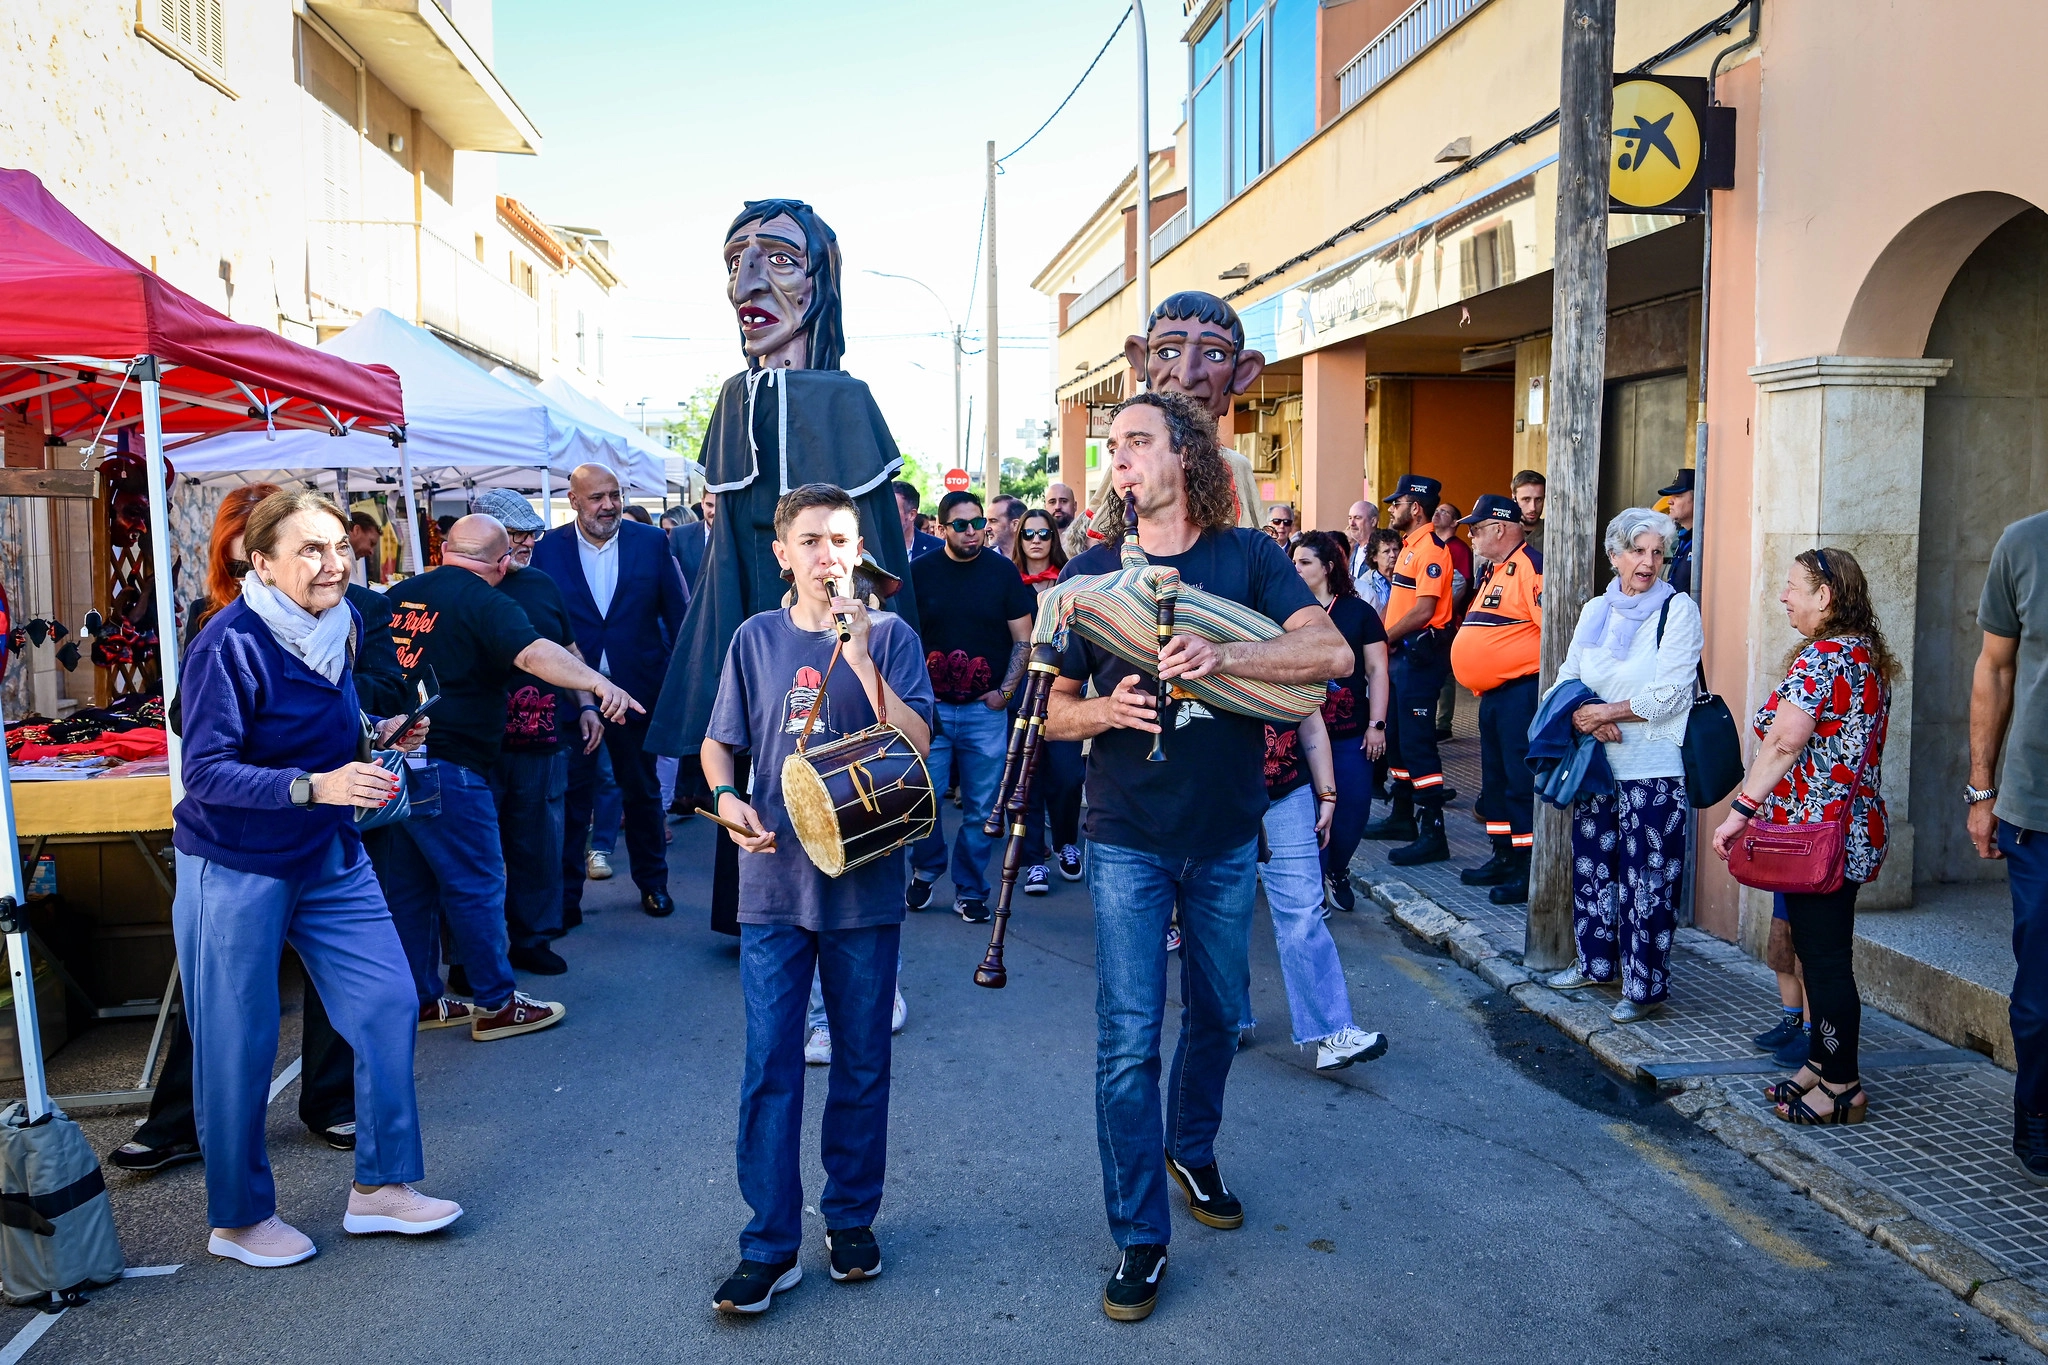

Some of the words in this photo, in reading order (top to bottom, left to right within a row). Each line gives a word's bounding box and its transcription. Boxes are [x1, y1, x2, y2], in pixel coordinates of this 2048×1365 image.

[1318, 268, 1378, 322] CaixaBank
[946, 477, 968, 485] STOP
[514, 1007, 526, 1023] G
